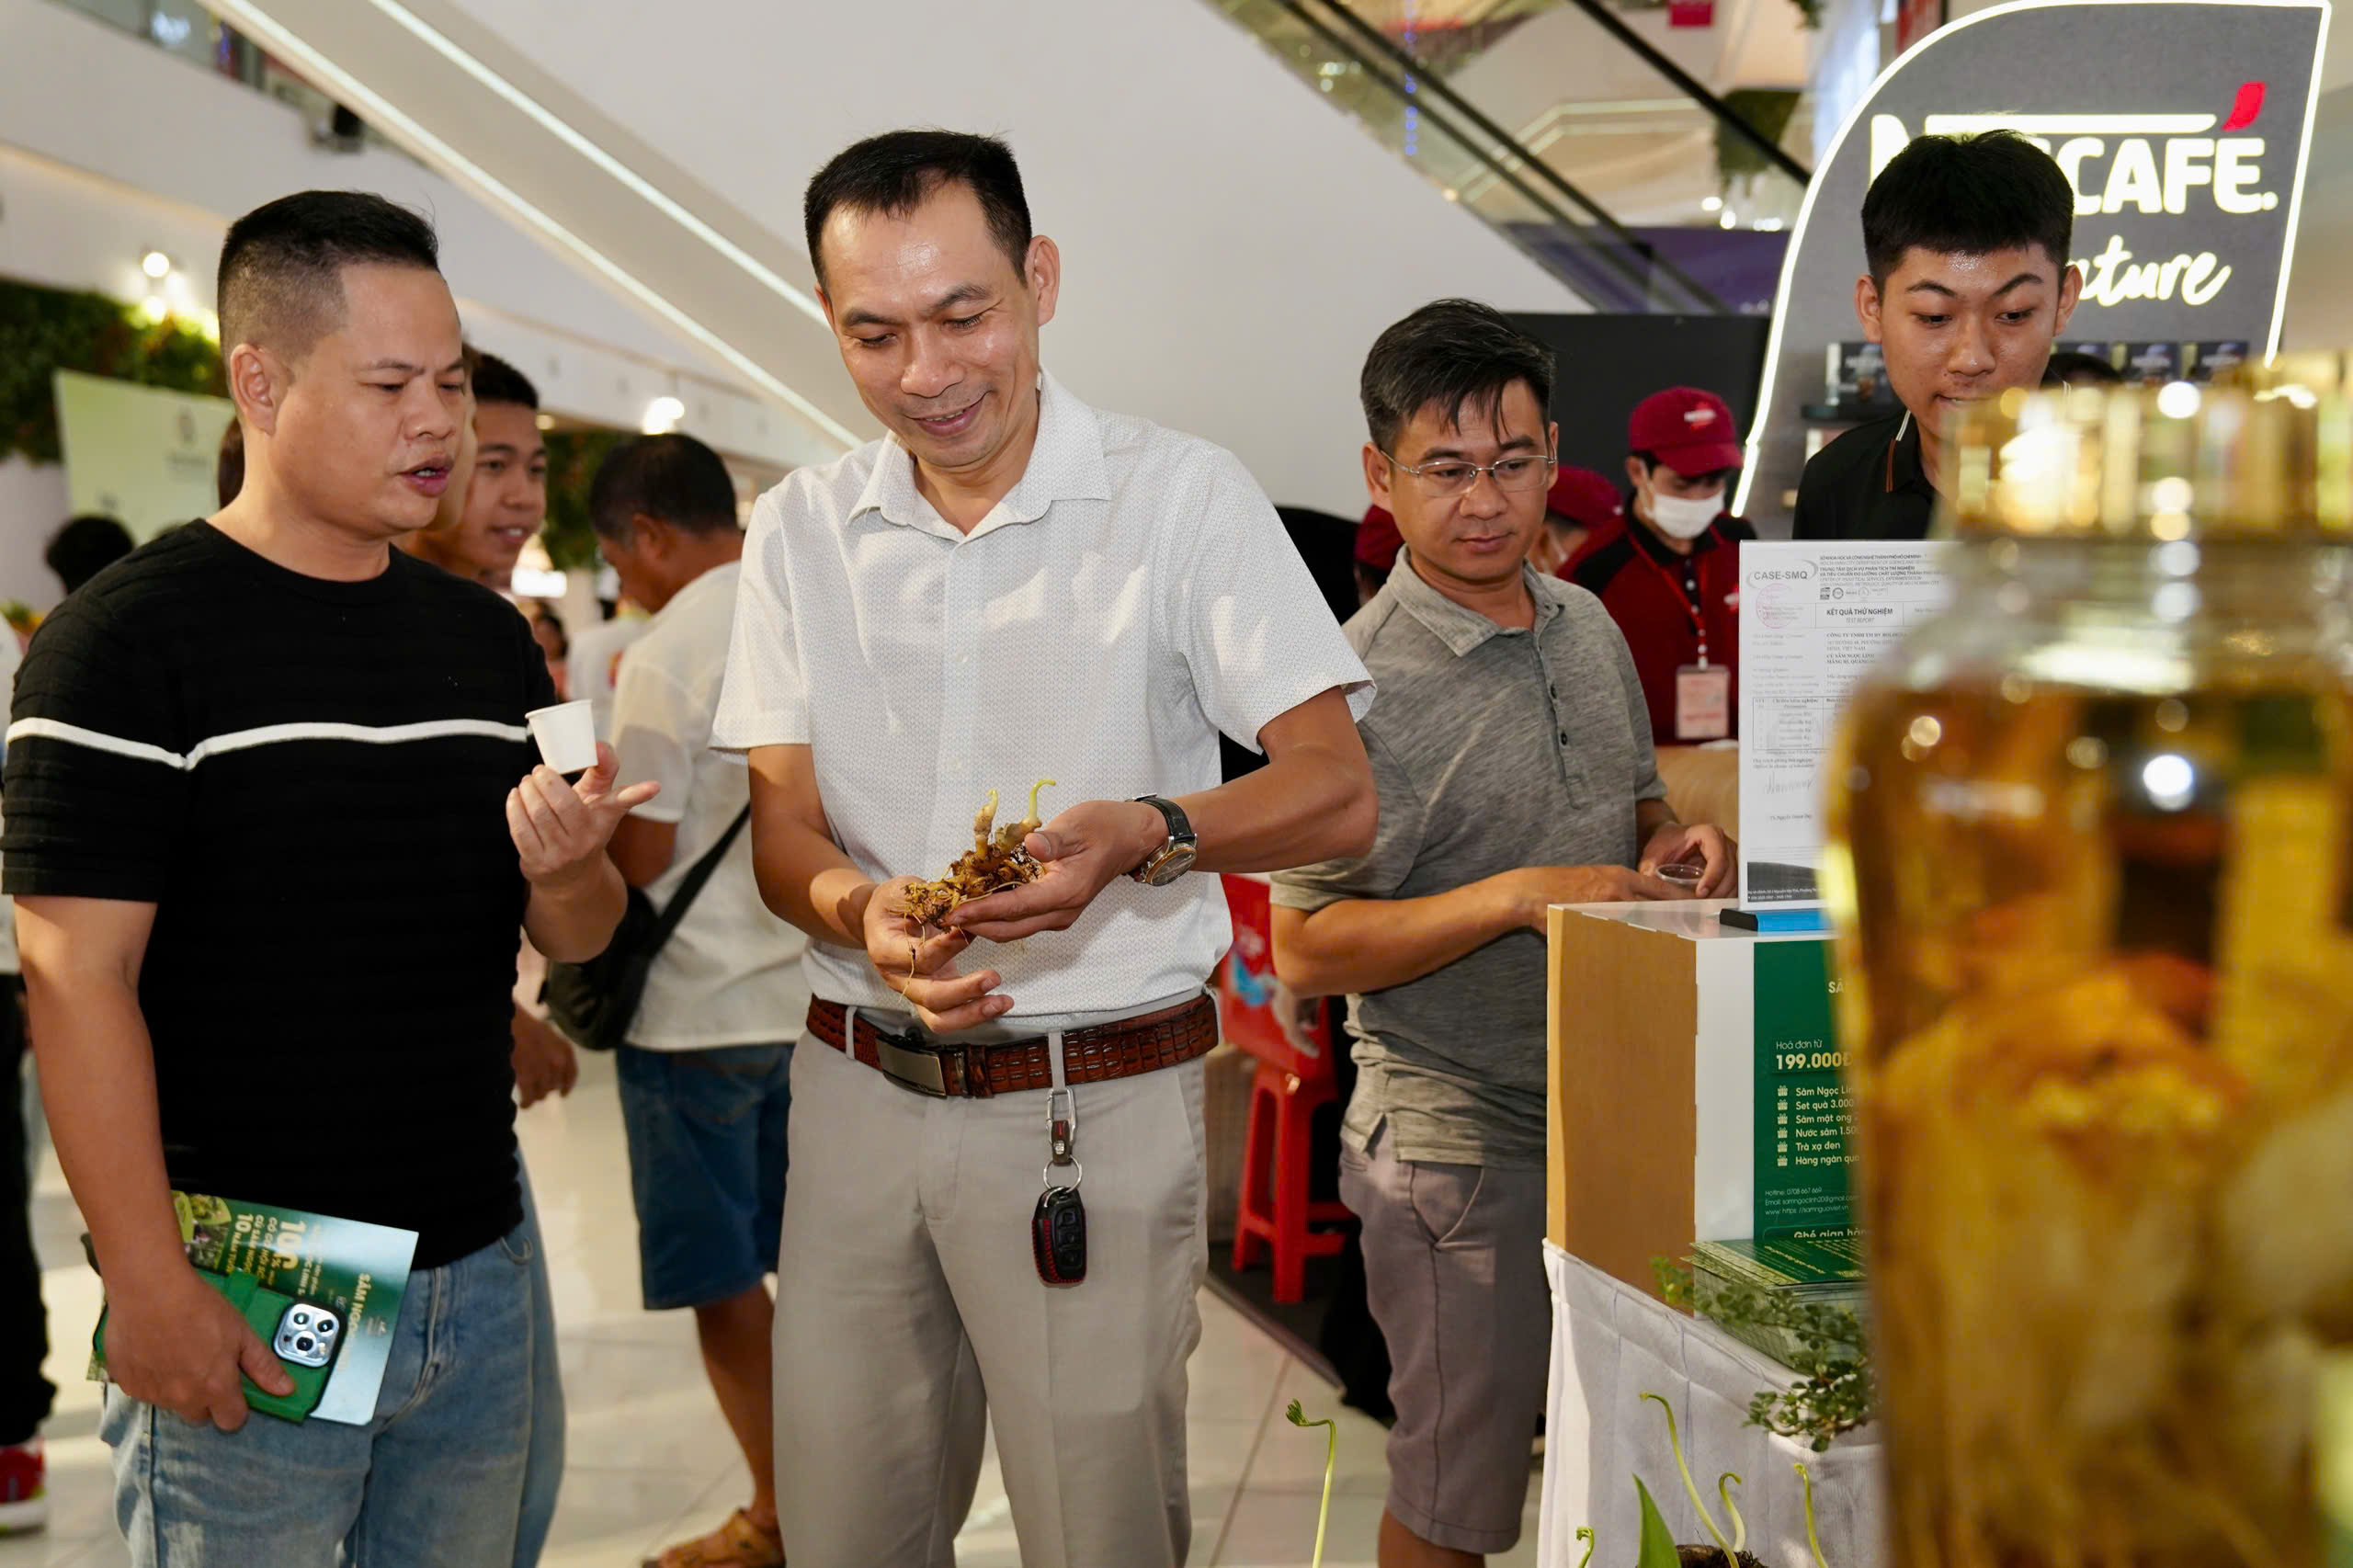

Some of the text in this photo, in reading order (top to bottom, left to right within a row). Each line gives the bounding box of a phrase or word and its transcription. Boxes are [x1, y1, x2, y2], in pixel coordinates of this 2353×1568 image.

[1754, 571, 1807, 580] CASE-SMQ
[1827, 608, 1838, 616] KẾT
[1868, 607, 1893, 617] NGHIỆM
[1795, 1040, 1812, 1049] đơn
[1817, 1086, 1838, 1097] Ngọc
[1841, 1085, 1854, 1094] Lin
[1796, 1101, 1810, 1110] Set
[1836, 1115, 1852, 1124] ong
[1824, 1141, 1840, 1150] đen
[235, 1214, 254, 1233] 10
